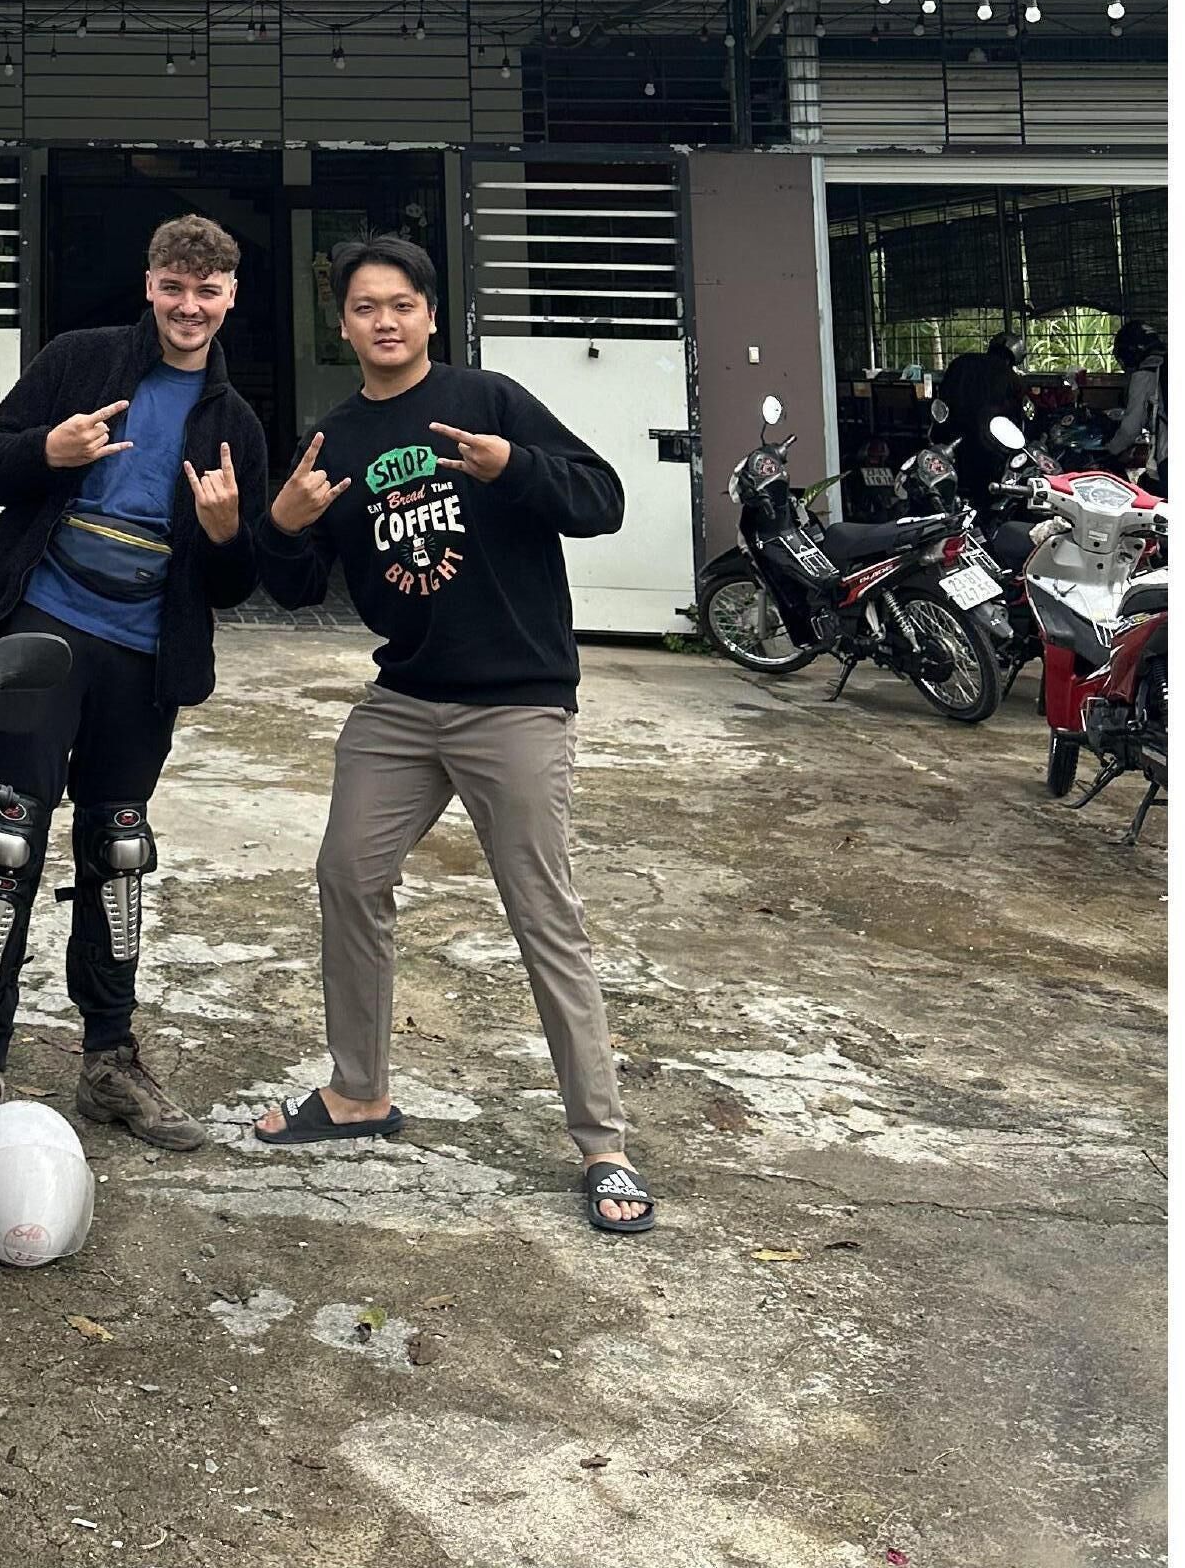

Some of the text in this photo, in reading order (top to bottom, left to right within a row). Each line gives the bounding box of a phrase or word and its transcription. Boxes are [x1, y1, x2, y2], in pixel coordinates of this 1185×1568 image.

[373, 448, 429, 488] SHOP
[367, 502, 382, 514] EAT
[386, 483, 426, 509] Bread
[374, 494, 466, 551] COFFEE
[385, 547, 464, 596] BRIGHT
[596, 1184, 648, 1198] adidas
